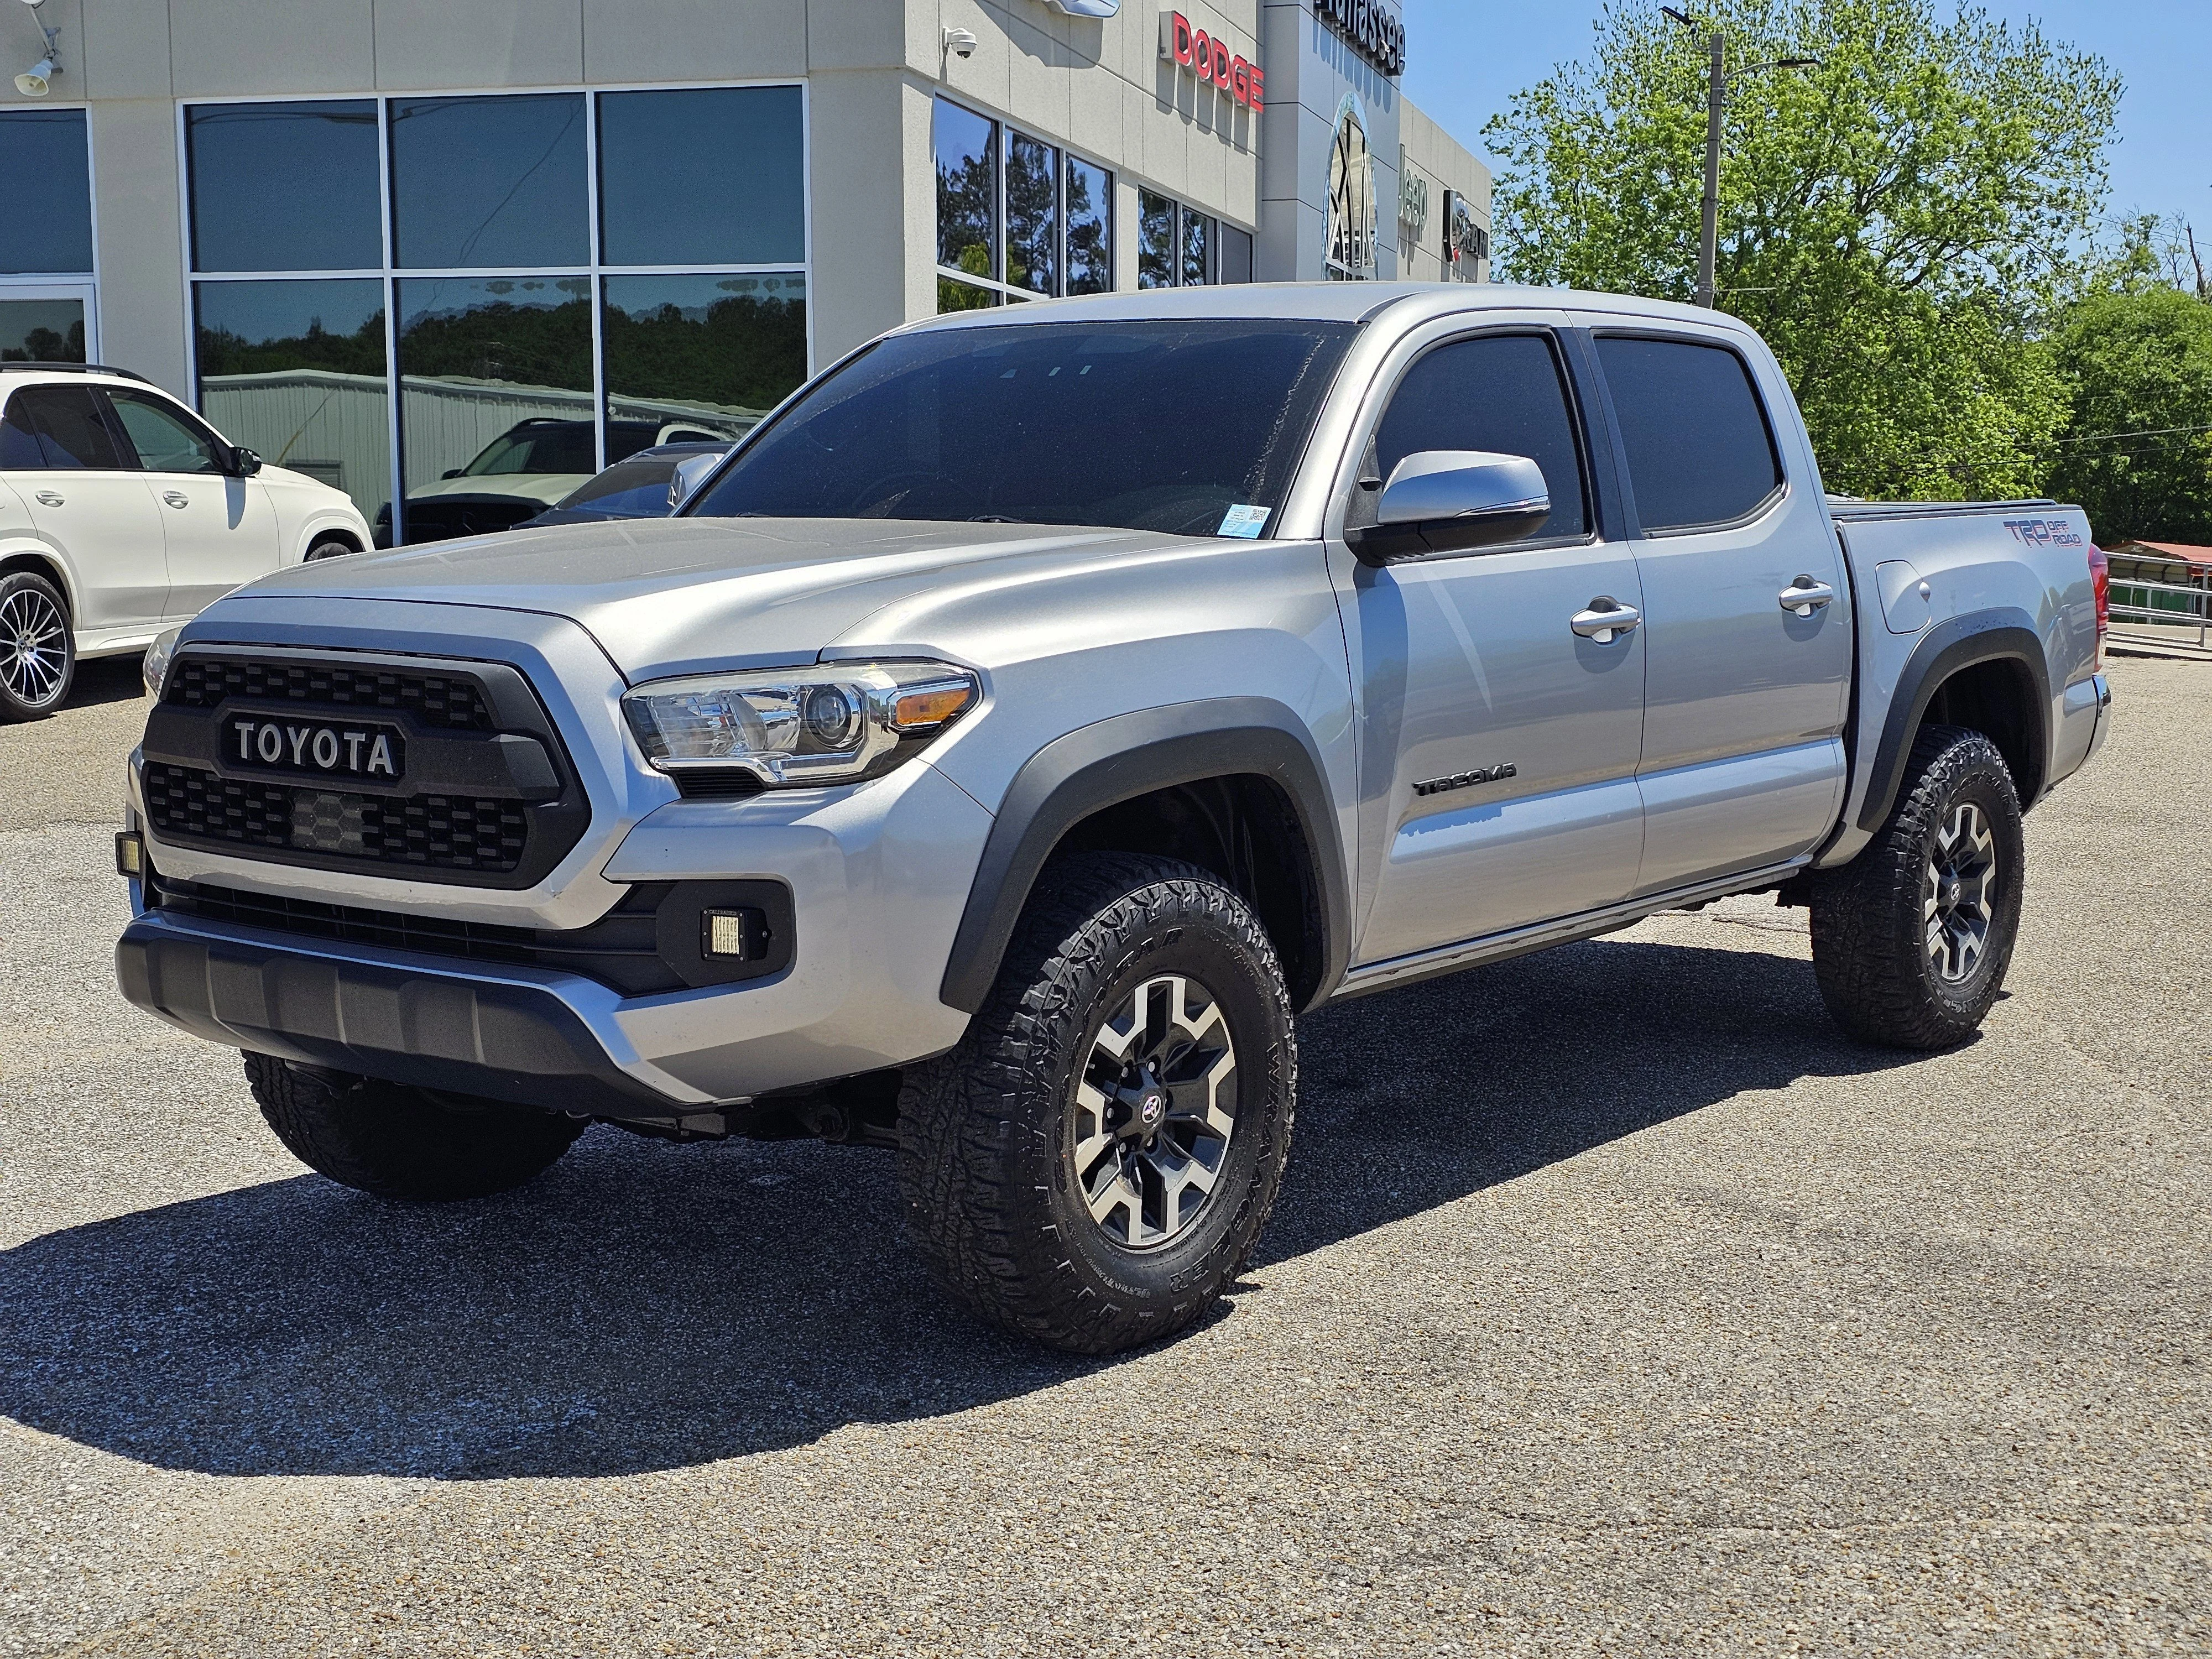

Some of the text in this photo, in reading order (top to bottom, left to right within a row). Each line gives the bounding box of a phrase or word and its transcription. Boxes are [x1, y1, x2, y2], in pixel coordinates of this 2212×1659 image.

[1169, 11, 1264, 114] DODGE
[1316, 0, 1406, 76] assee
[1398, 143, 1427, 242] Jeep
[1463, 219, 1488, 260] RAM
[2003, 519, 2068, 548] TRD OFF
[2052, 534, 2083, 547] ROAD
[234, 722, 394, 774] TOYOTA
[1413, 761, 1517, 796] TACOMA
[1168, 1042, 1281, 1293] WRANGLER
